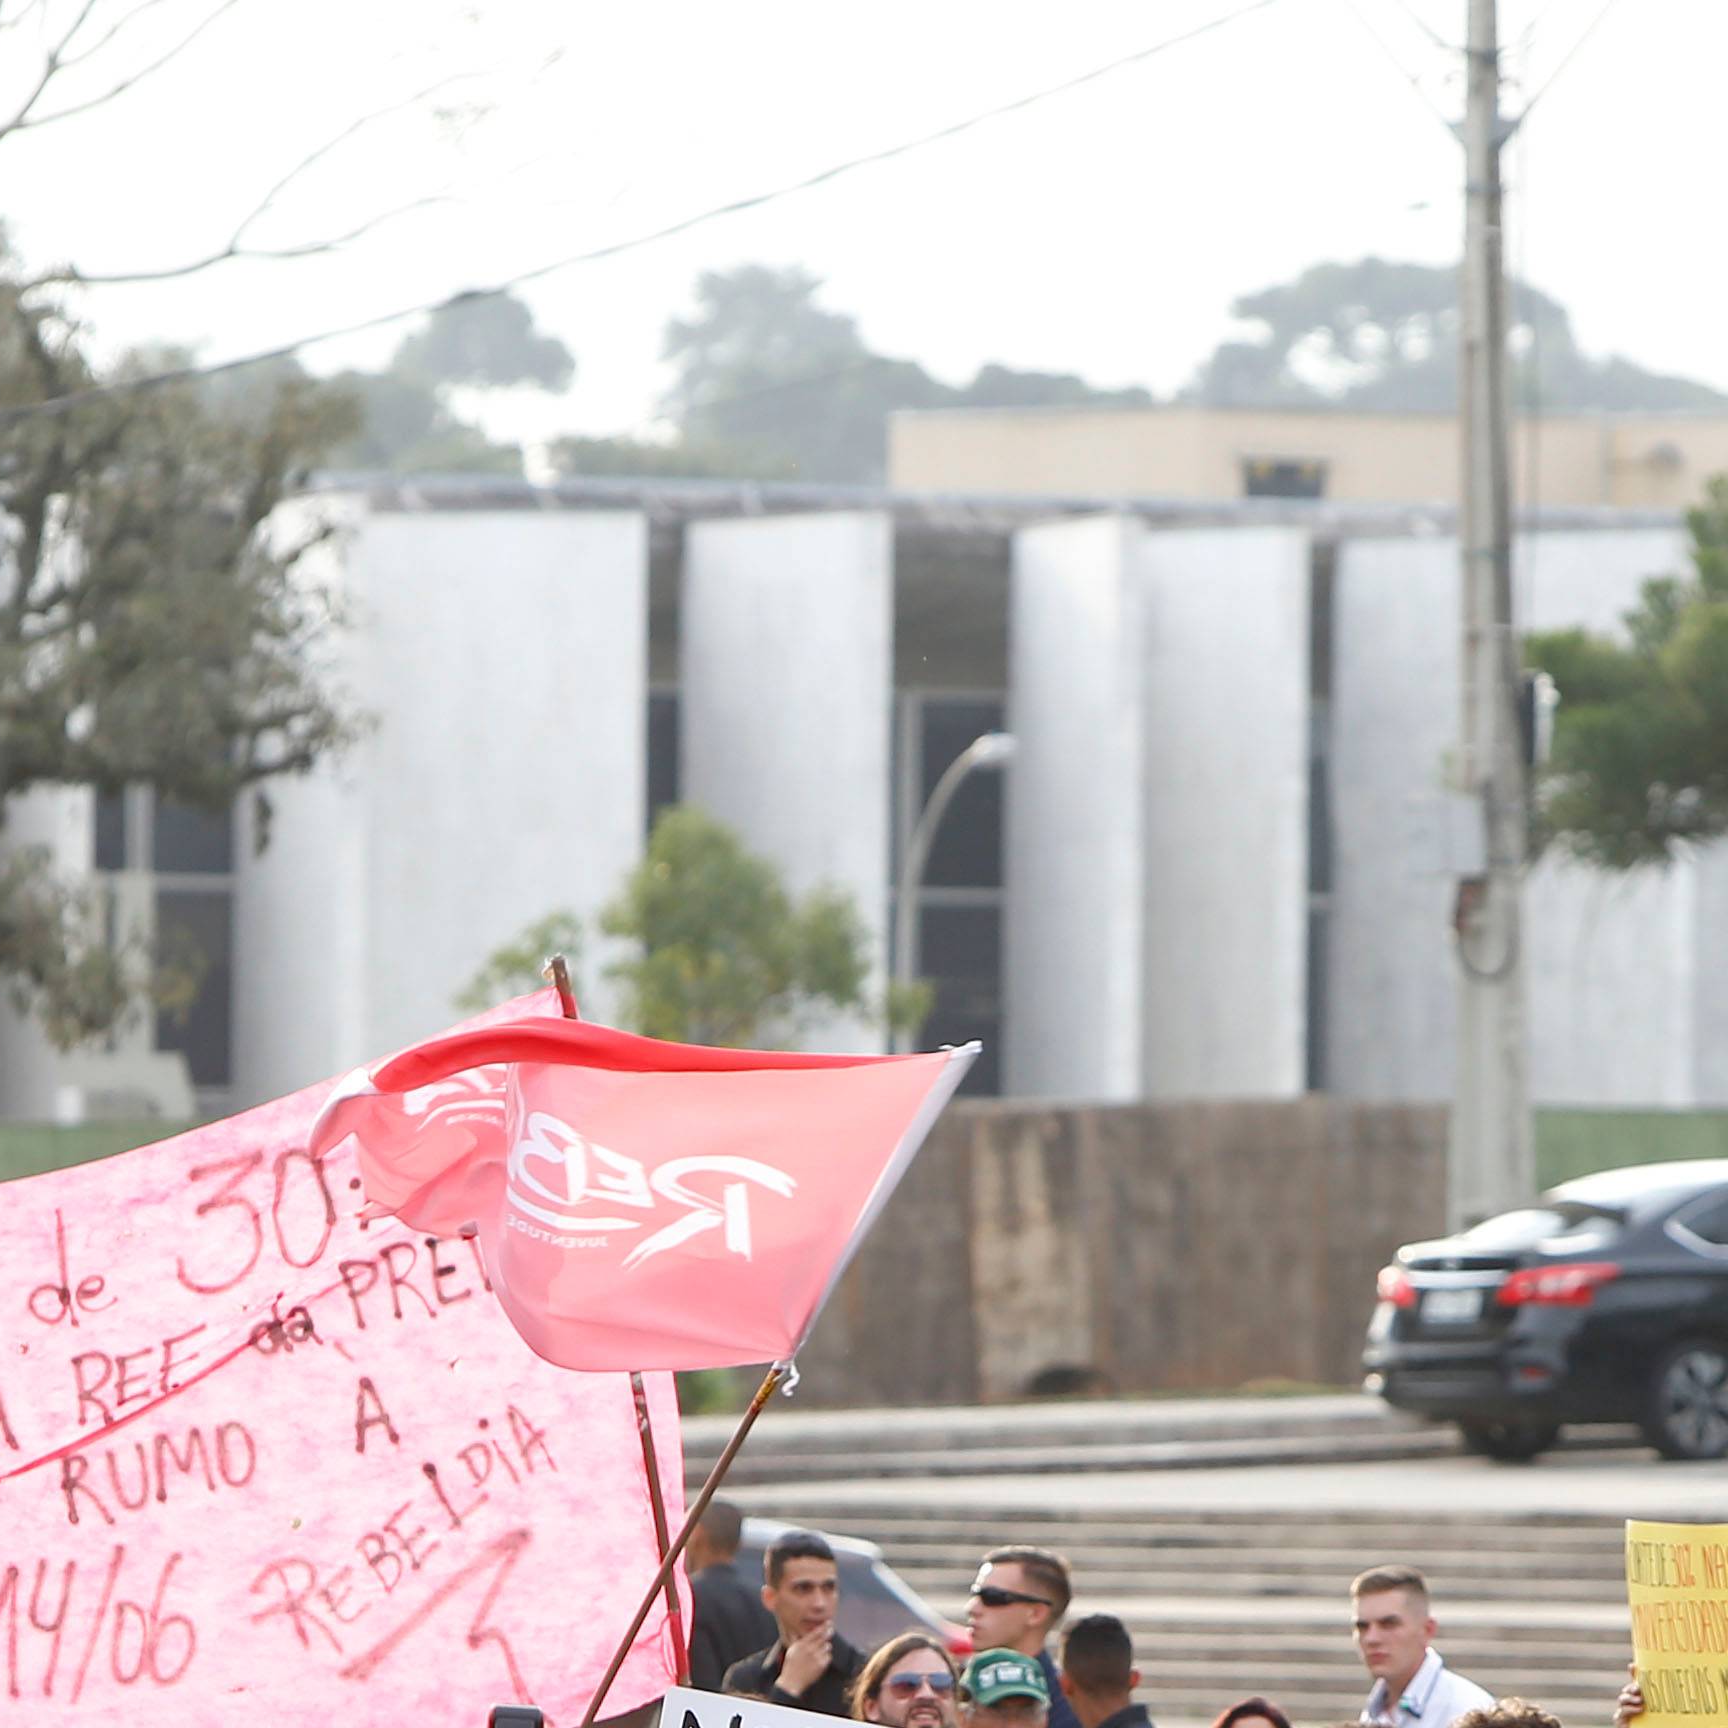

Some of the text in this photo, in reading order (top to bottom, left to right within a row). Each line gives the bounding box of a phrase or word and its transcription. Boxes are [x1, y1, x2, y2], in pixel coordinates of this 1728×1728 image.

[27, 1207, 118, 1328] de
[60, 1421, 259, 1527] RUMO
[353, 1375, 401, 1454] A
